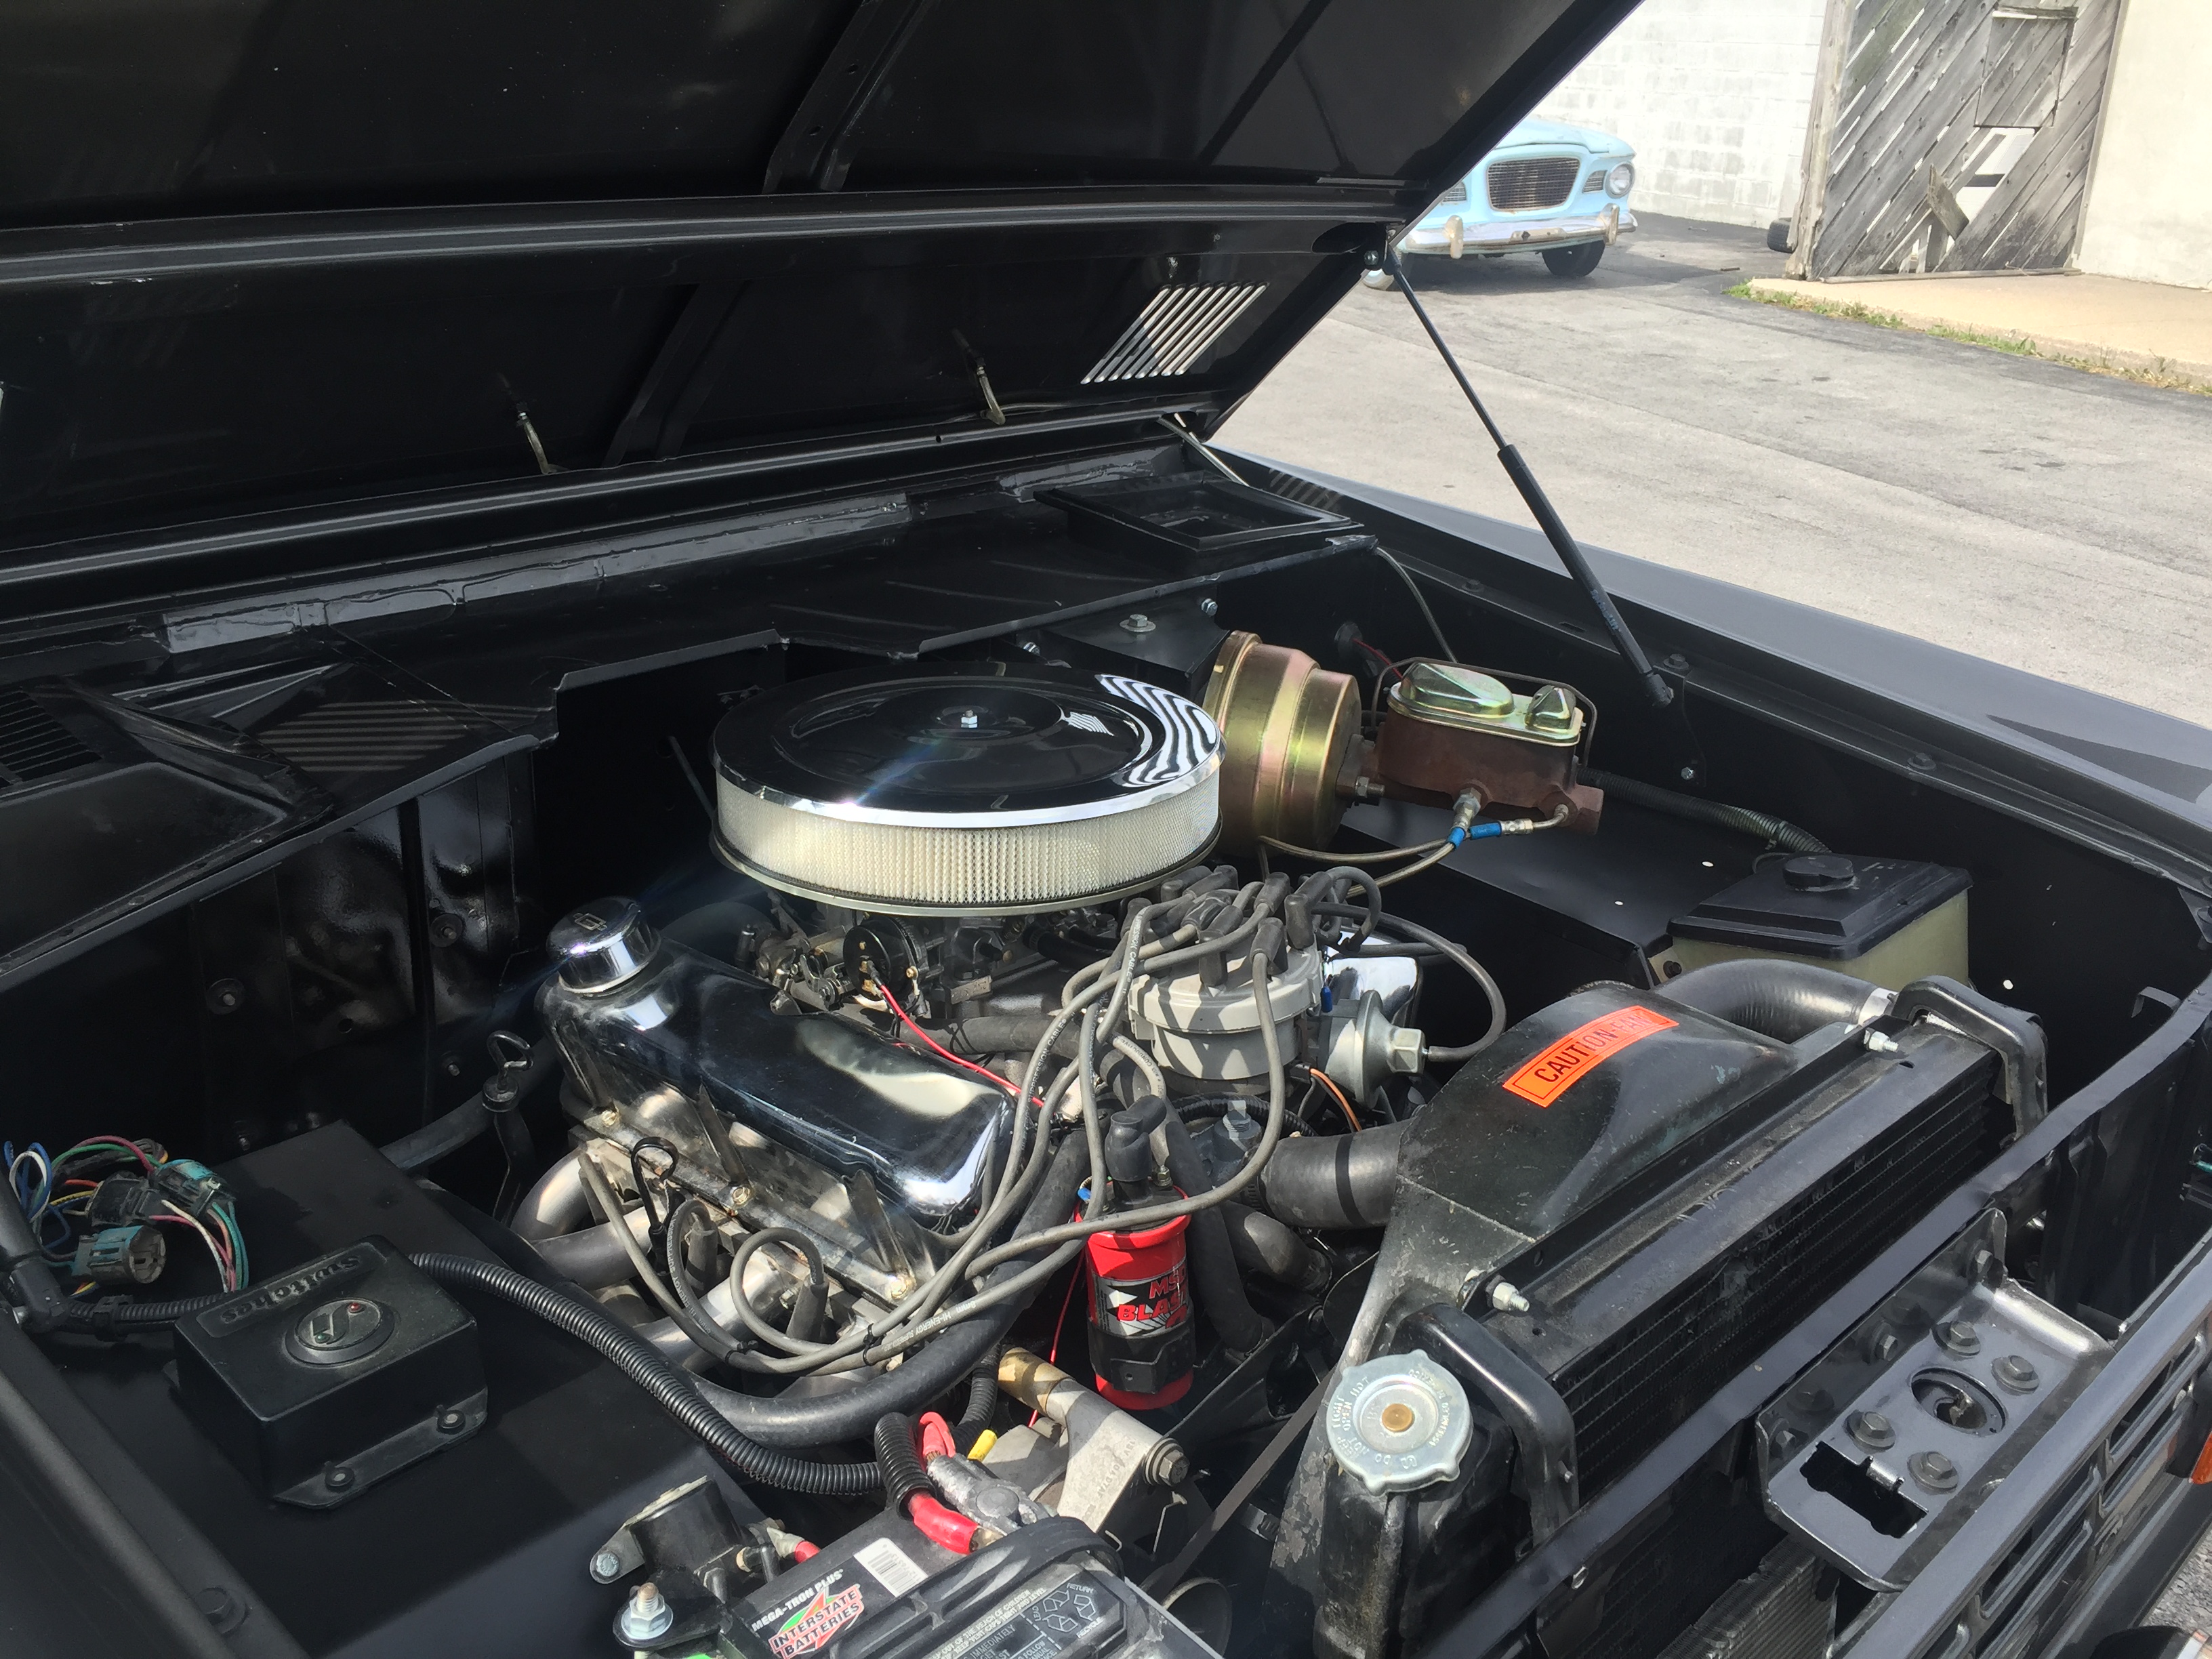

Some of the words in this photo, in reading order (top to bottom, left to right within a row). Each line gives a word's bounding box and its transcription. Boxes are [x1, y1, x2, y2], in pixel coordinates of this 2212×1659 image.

[1534, 1013, 1650, 1083] CAUTION-FAN
[1149, 1264, 1185, 1299] MSD
[916, 1311, 951, 1335] HI-ENERGY
[956, 1300, 977, 1313] 8mm
[1066, 1582, 1094, 1594] RETURN
[752, 1587, 815, 1632] MEGA-TRON
[773, 1589, 857, 1648] INTERSTATE
[1032, 1605, 1041, 1622] LEAD
[785, 1602, 860, 1656] BATTERIES
[970, 1624, 1016, 1659] IMMEDIATELY
[1076, 1616, 1106, 1639] RECYCLE
